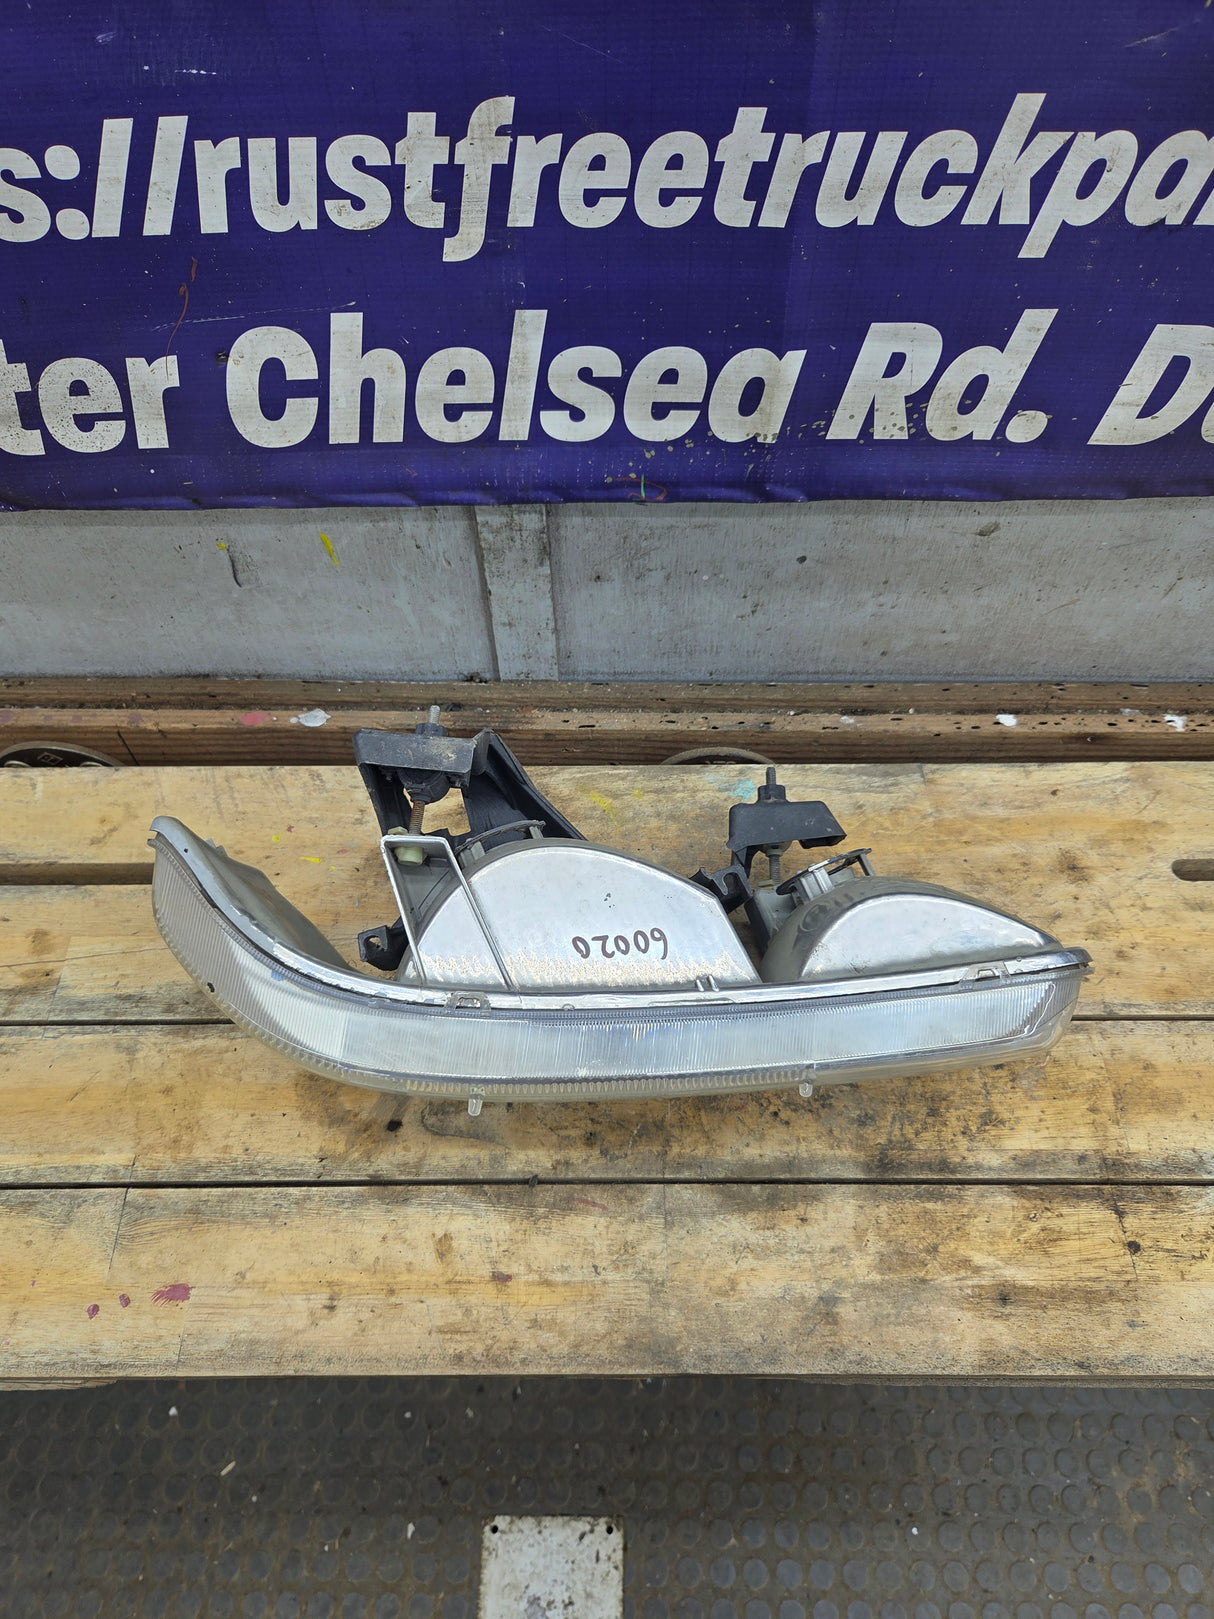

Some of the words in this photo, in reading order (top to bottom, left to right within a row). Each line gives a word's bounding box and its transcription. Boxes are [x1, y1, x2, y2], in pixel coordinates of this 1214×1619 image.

[225, 309, 808, 449] Chelsea
[825, 308, 1059, 444] Rd.
[1086, 323, 1214, 446] D
[571, 926, 669, 961] 60020
